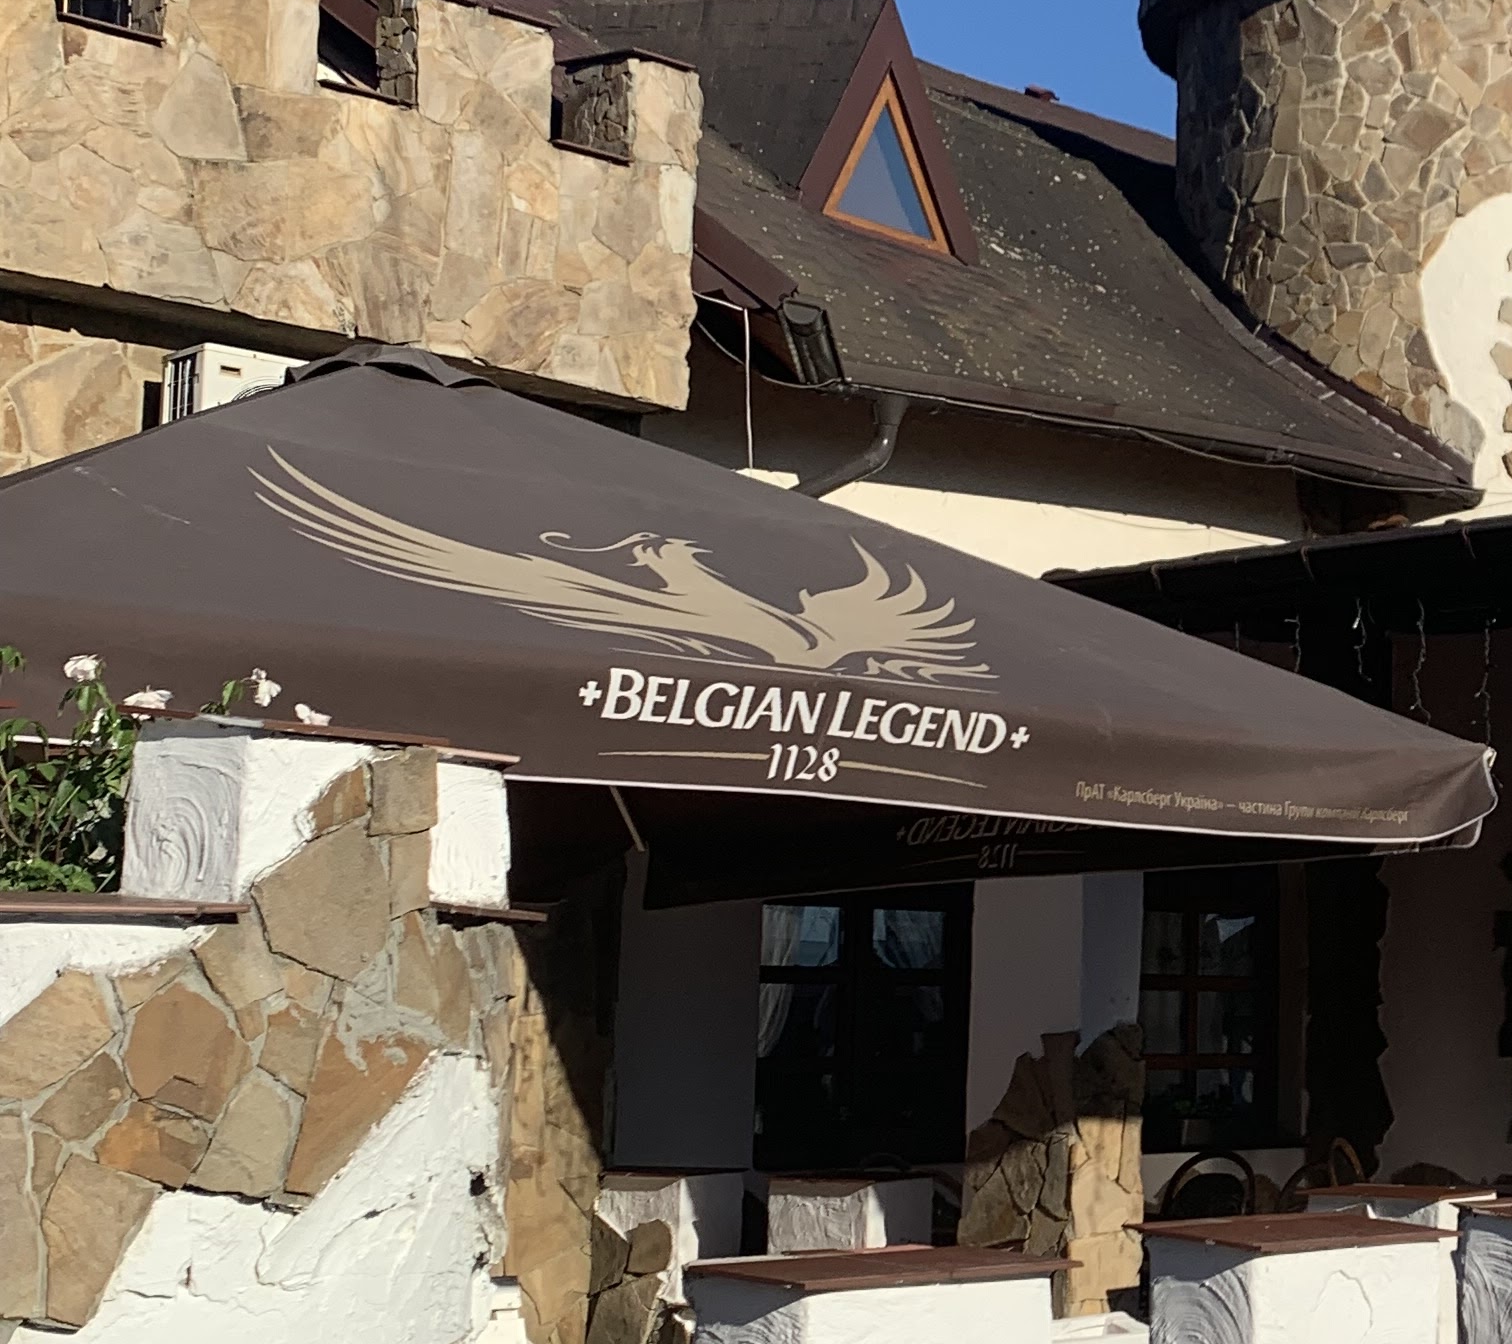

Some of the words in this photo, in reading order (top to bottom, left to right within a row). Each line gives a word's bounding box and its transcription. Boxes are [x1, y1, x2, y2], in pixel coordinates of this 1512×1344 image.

[600, 667, 827, 734] BELGIAN
[826, 690, 1008, 754] LEGEND
[767, 743, 841, 783] 1128
[1075, 780, 1106, 802] ПрАТ
[1238, 801, 1282, 816] частина
